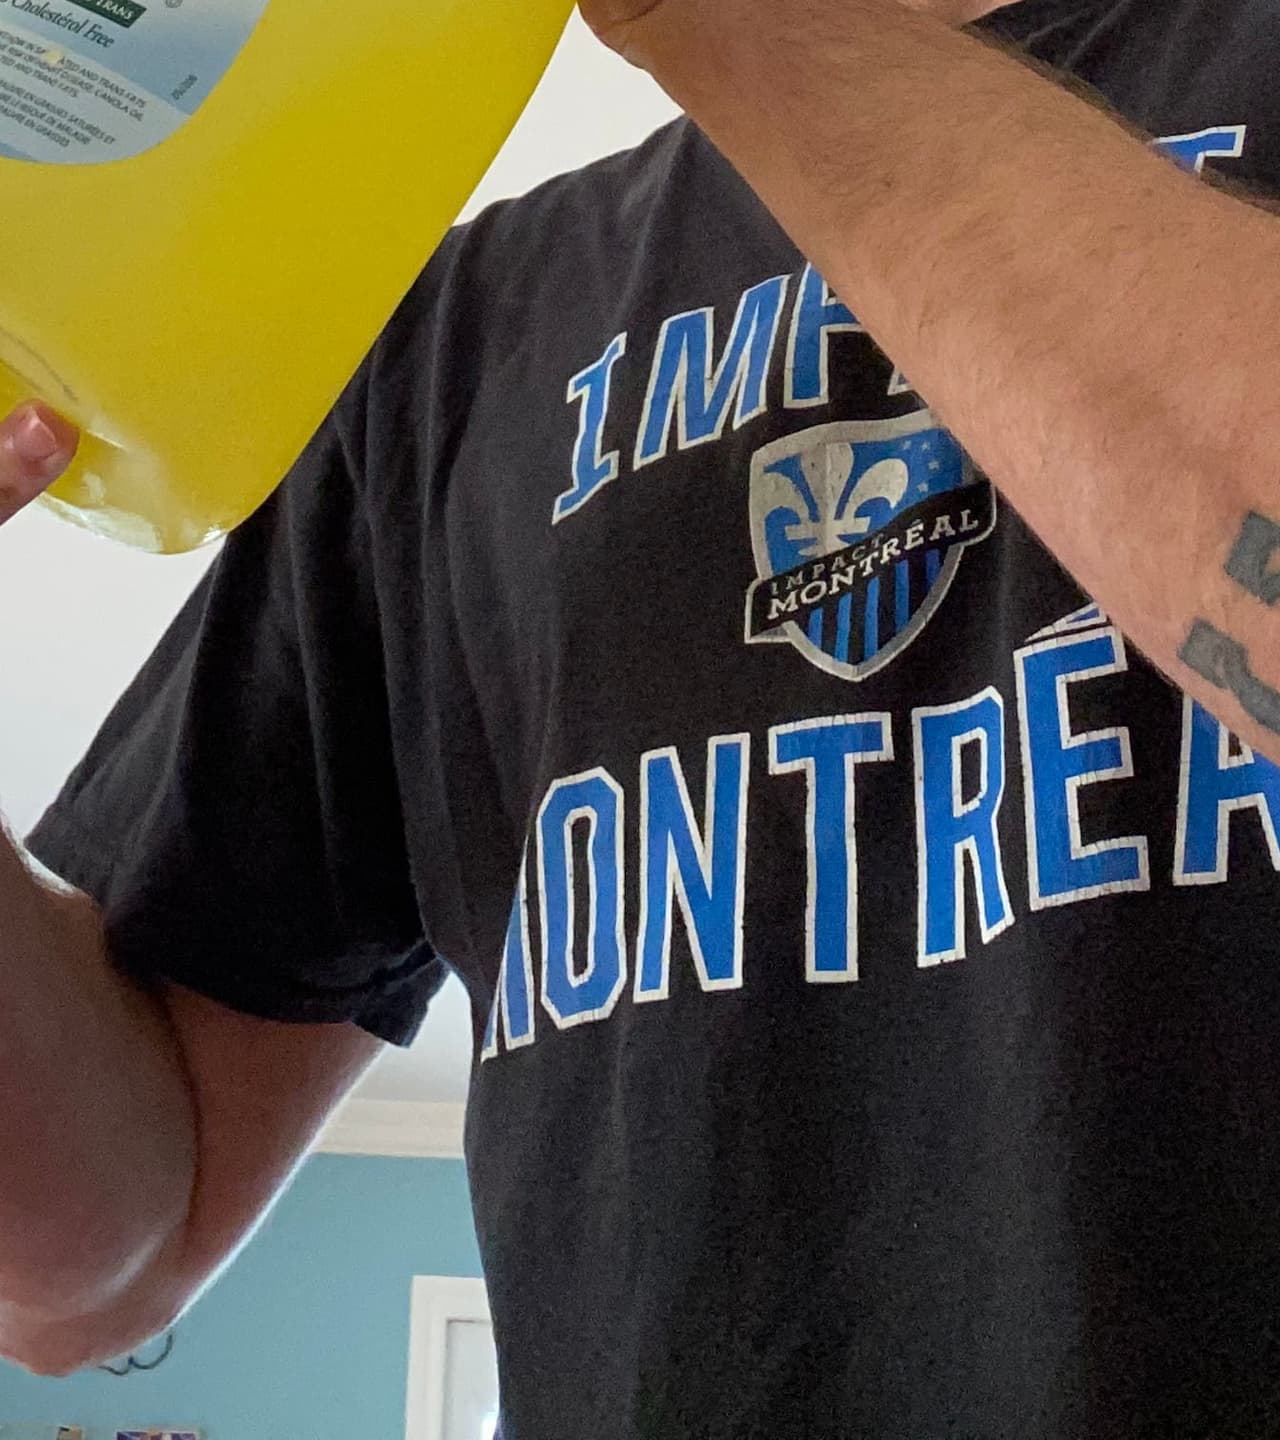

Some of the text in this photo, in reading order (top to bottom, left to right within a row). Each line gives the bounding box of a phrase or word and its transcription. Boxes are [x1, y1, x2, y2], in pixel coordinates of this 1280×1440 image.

[83, 22, 116, 48] Free
[767, 509, 980, 620] MONTRÉAL
[771, 532, 886, 594] IMPACT
